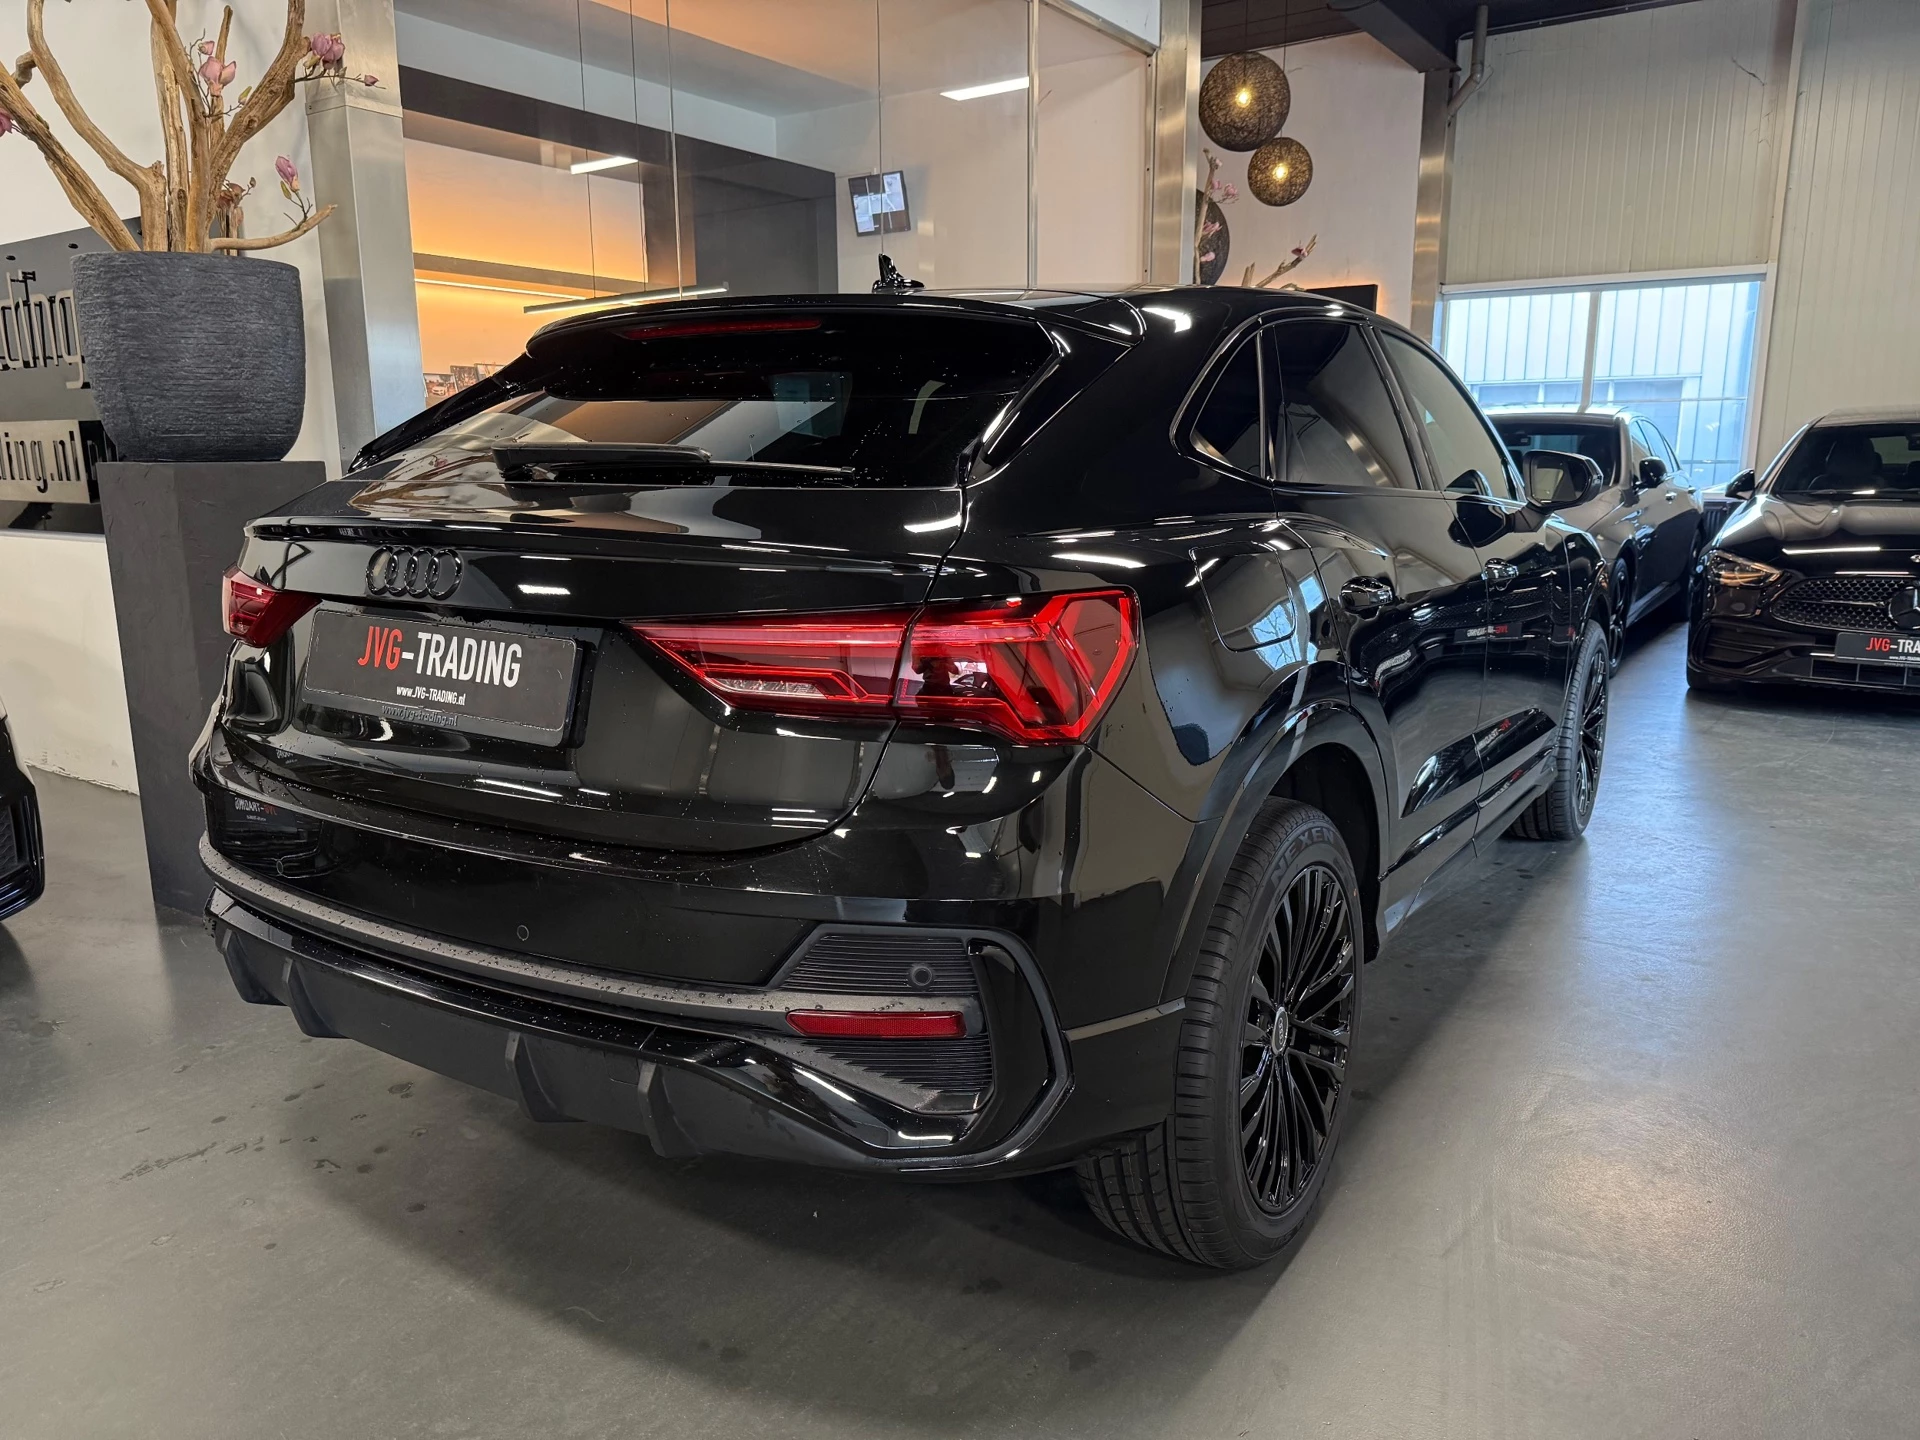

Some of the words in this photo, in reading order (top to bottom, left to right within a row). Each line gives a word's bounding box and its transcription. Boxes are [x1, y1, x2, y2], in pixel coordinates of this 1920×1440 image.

[357, 625, 523, 688] JVG-TRADING
[382, 704, 458, 727] www.jvg-trading.nl
[396, 686, 466, 706] www.JVG-TRADING.nl
[1270, 826, 1335, 889] NEXEN
